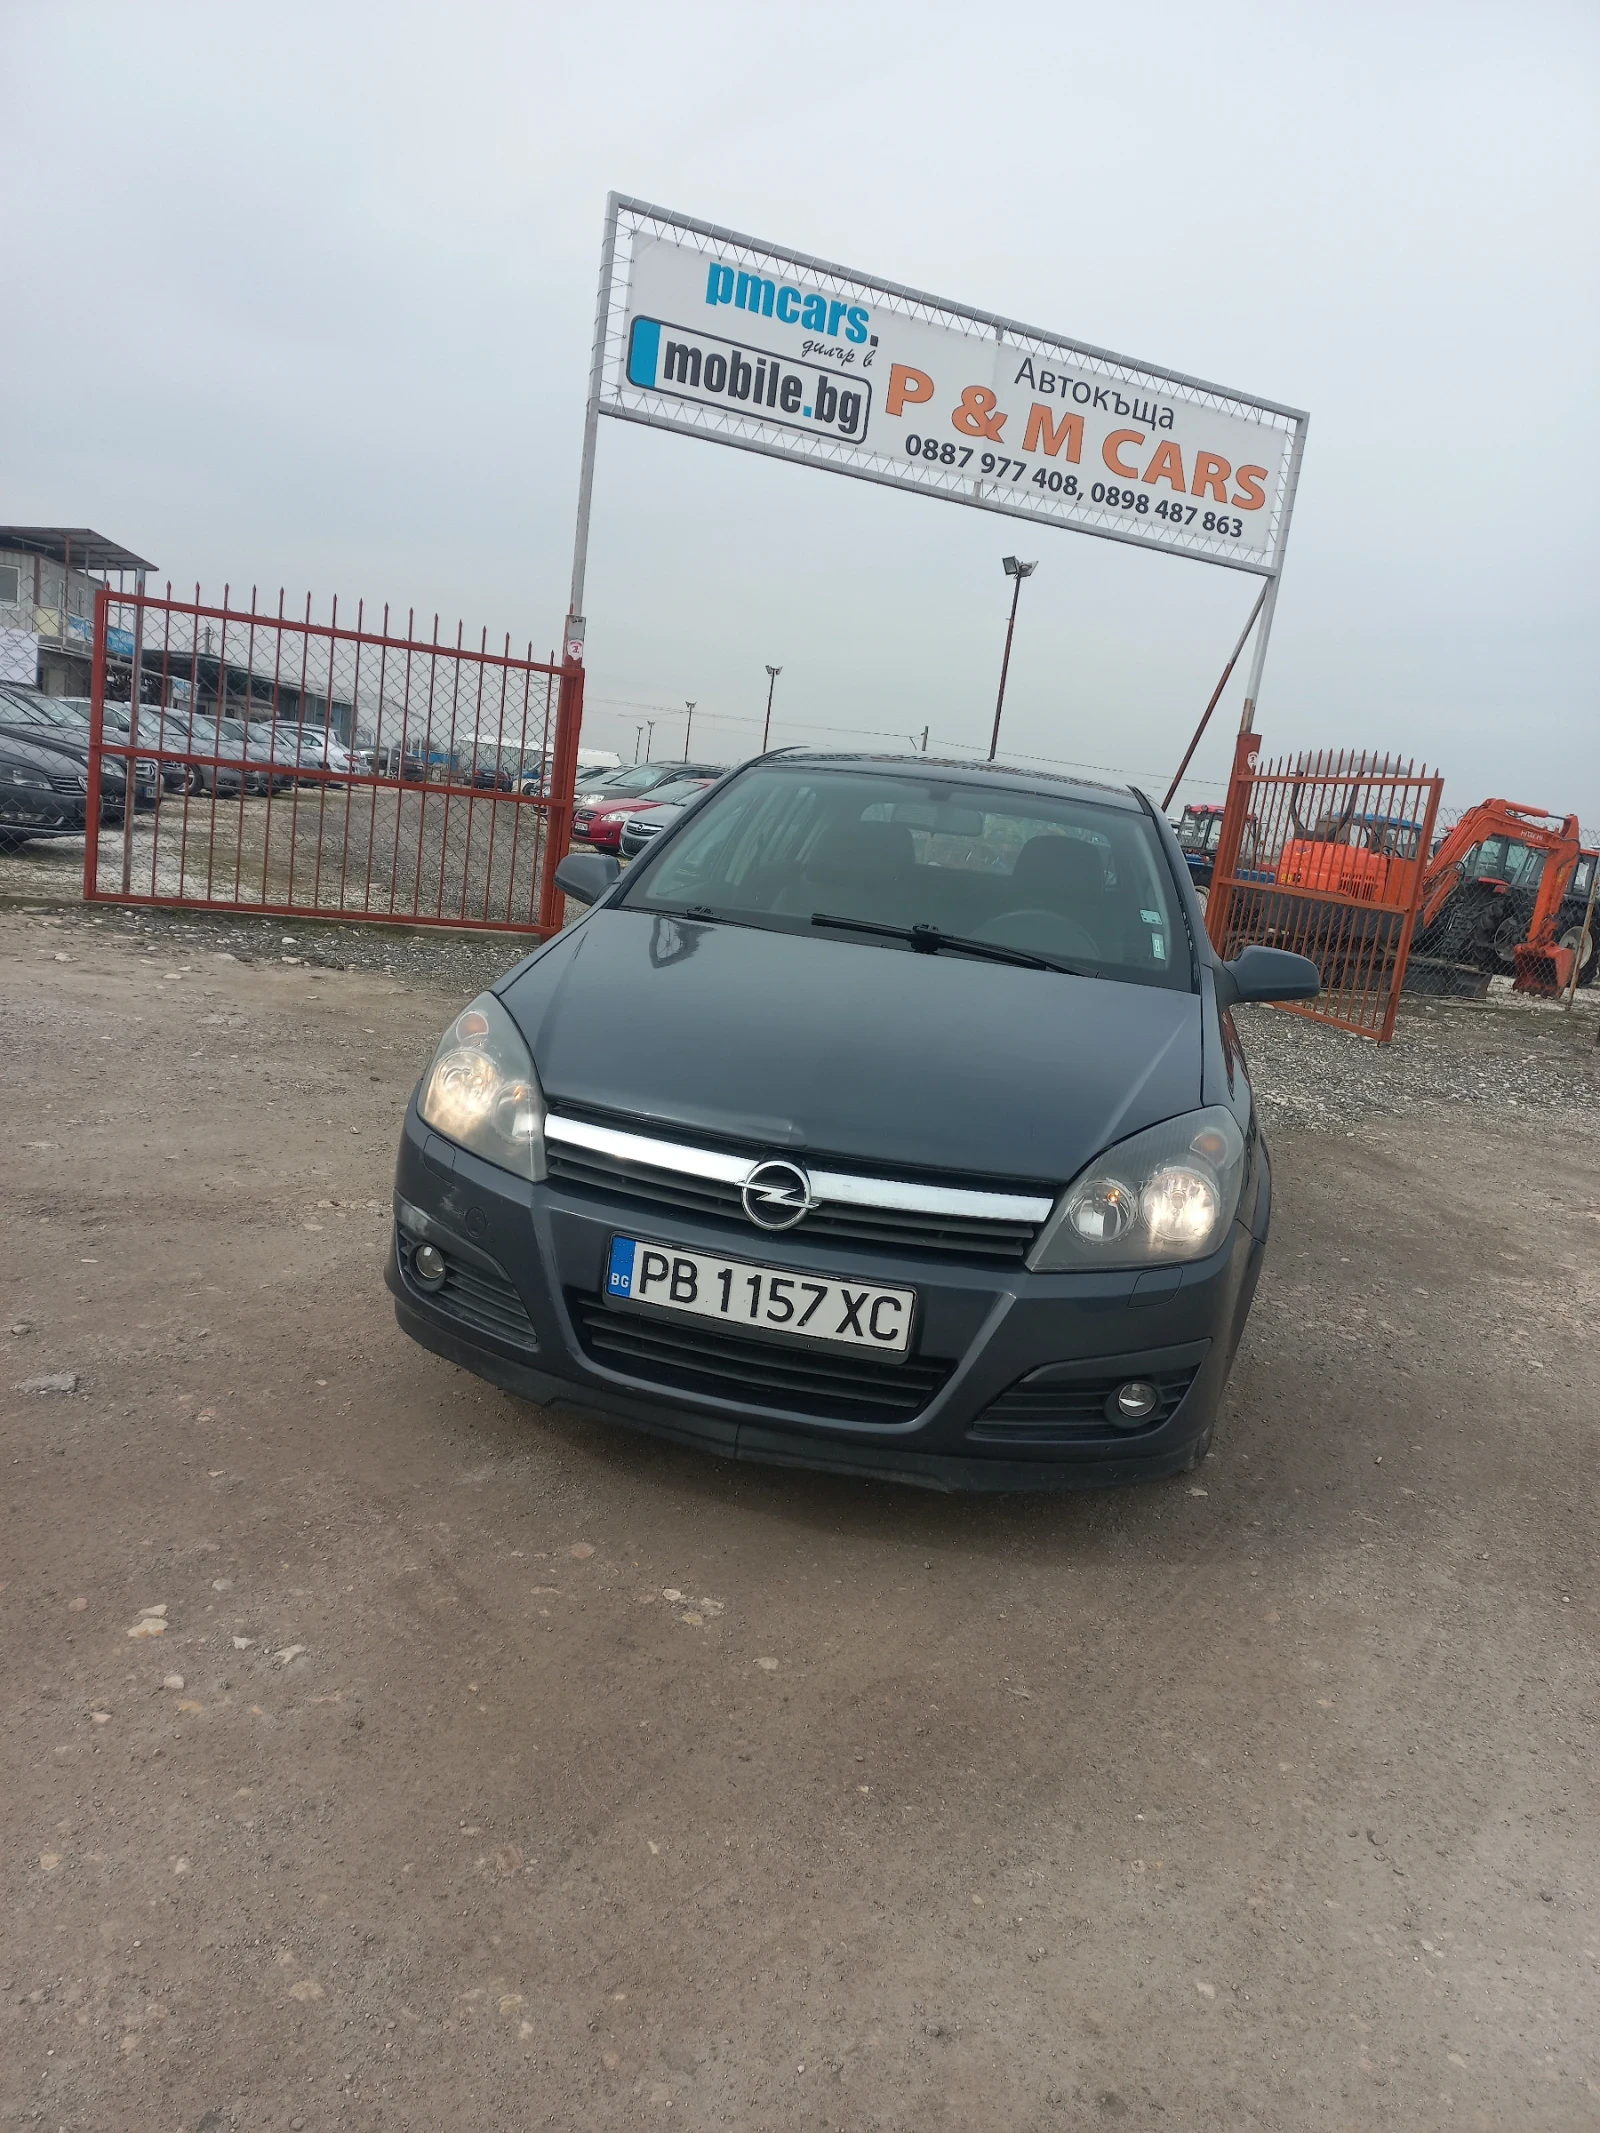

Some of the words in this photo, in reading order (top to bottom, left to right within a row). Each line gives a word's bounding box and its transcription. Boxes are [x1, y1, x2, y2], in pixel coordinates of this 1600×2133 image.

[663, 340, 863, 435] mobile.bg
[801, 339, 856, 367] дилър
[862, 348, 876, 368] в
[1014, 356, 1175, 430] Автокъща
[885, 362, 935, 417] P
[951, 385, 1008, 444] &
[1021, 402, 1085, 464] M
[1101, 428, 1269, 511] CARS
[905, 433, 974, 469] 0887
[980, 452, 1027, 482] 977
[1032, 467, 1084, 501] 408,
[1090, 481, 1150, 515] 0898
[1154, 500, 1198, 527] 487
[1201, 511, 1244, 538] 863
[610, 1271, 630, 1289] BG
[638, 1250, 698, 1304] PB
[717, 1268, 829, 1327] 1157
[835, 1289, 903, 1341] XC
